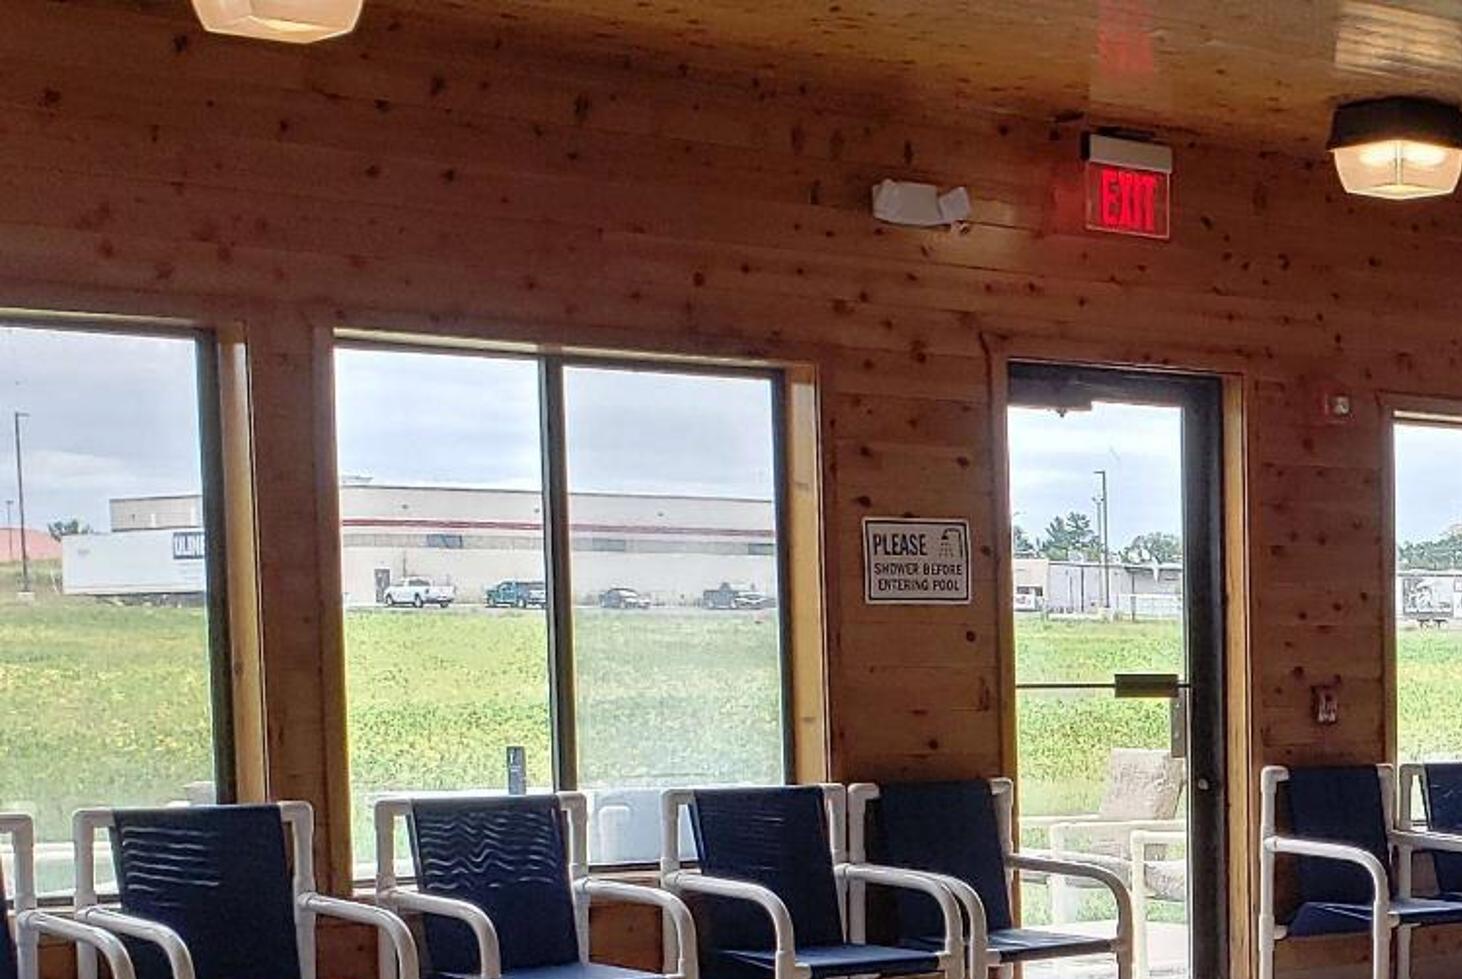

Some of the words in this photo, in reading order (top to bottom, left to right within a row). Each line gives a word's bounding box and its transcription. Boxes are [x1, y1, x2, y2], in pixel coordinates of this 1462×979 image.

[1100, 167, 1157, 233] EXIT
[873, 533, 928, 556] PLEASE
[874, 562, 919, 576] SHOWER
[923, 563, 962, 576] BEFORE
[878, 578, 929, 591] ENTERING
[932, 579, 960, 591] POOL
